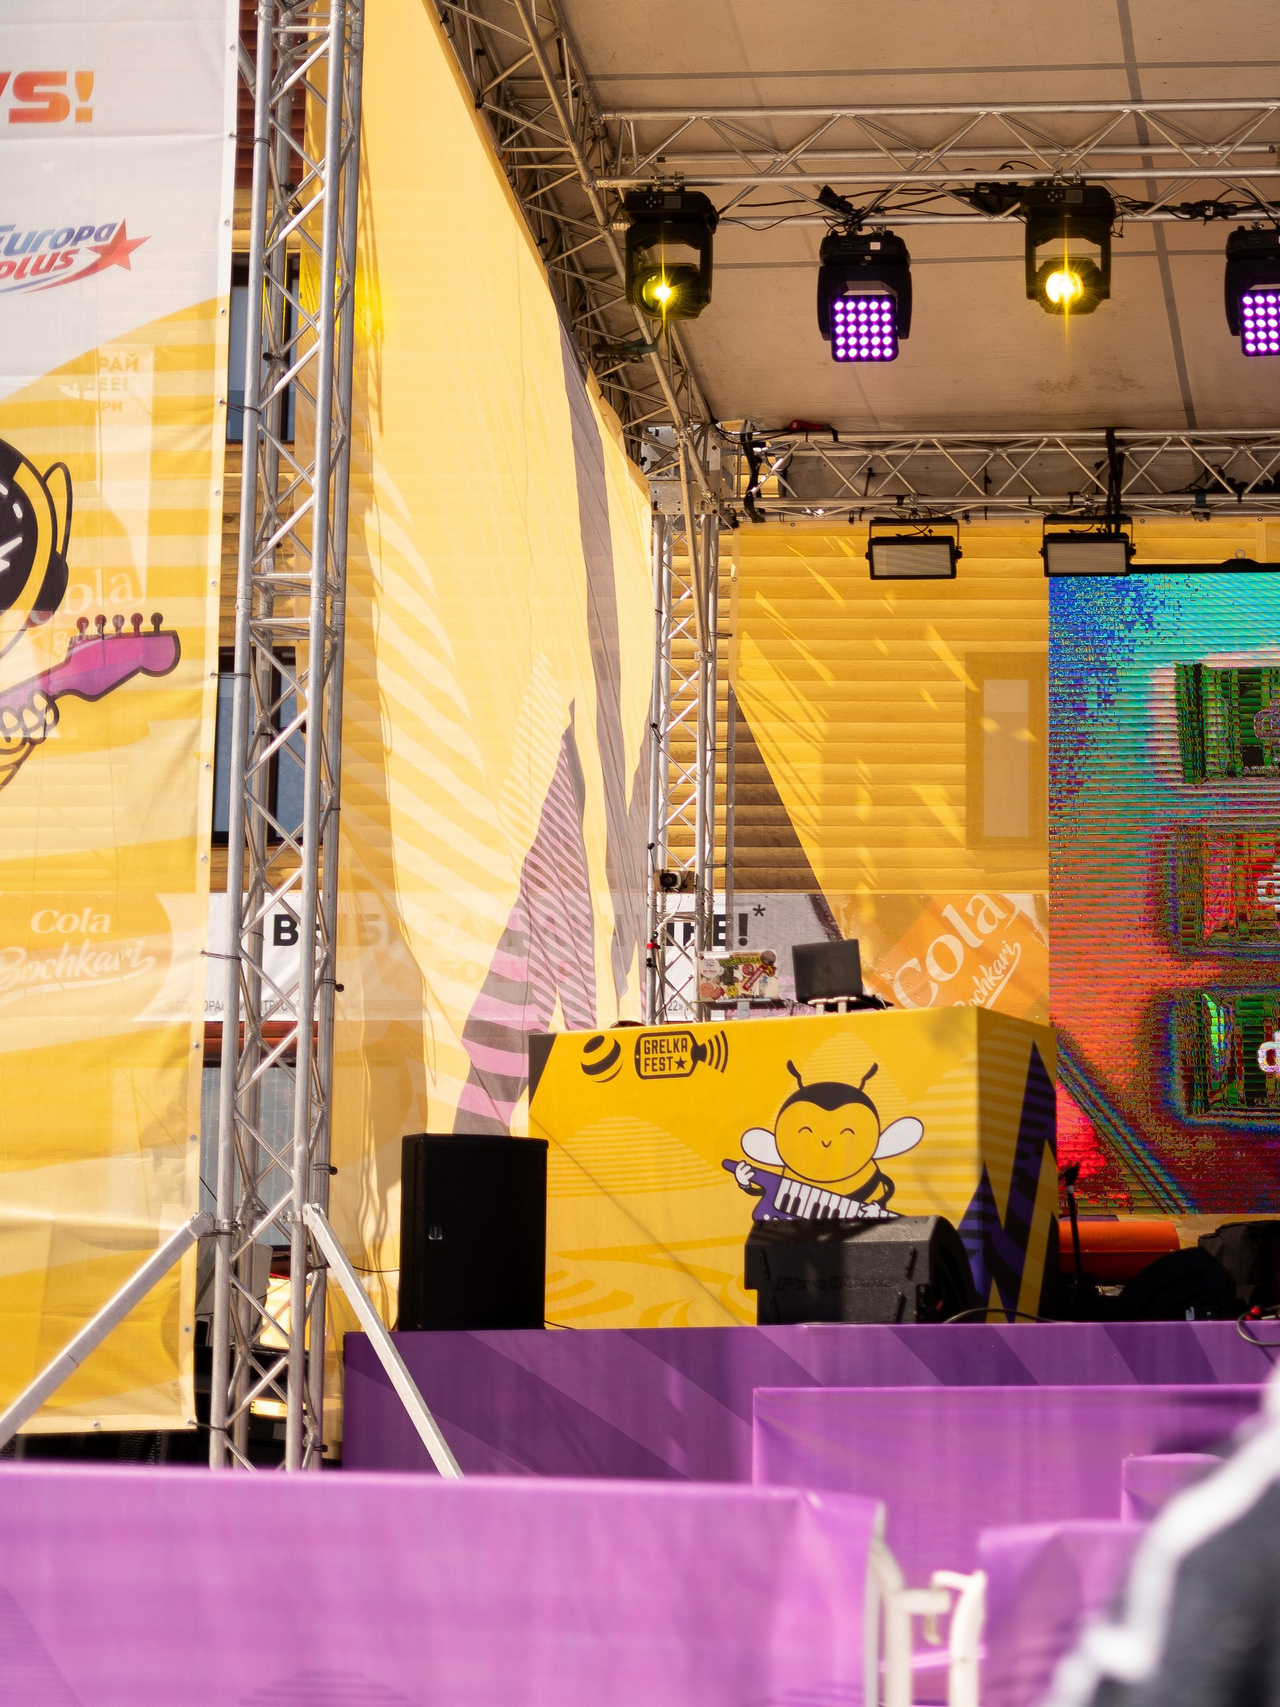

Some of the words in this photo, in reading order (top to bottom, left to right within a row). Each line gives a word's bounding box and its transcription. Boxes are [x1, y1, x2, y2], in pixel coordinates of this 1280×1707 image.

[31, 907, 111, 934] Cola
[893, 893, 1008, 1008] Cola
[643, 1037, 688, 1055] GRELKA
[644, 1056, 674, 1073] FEST
